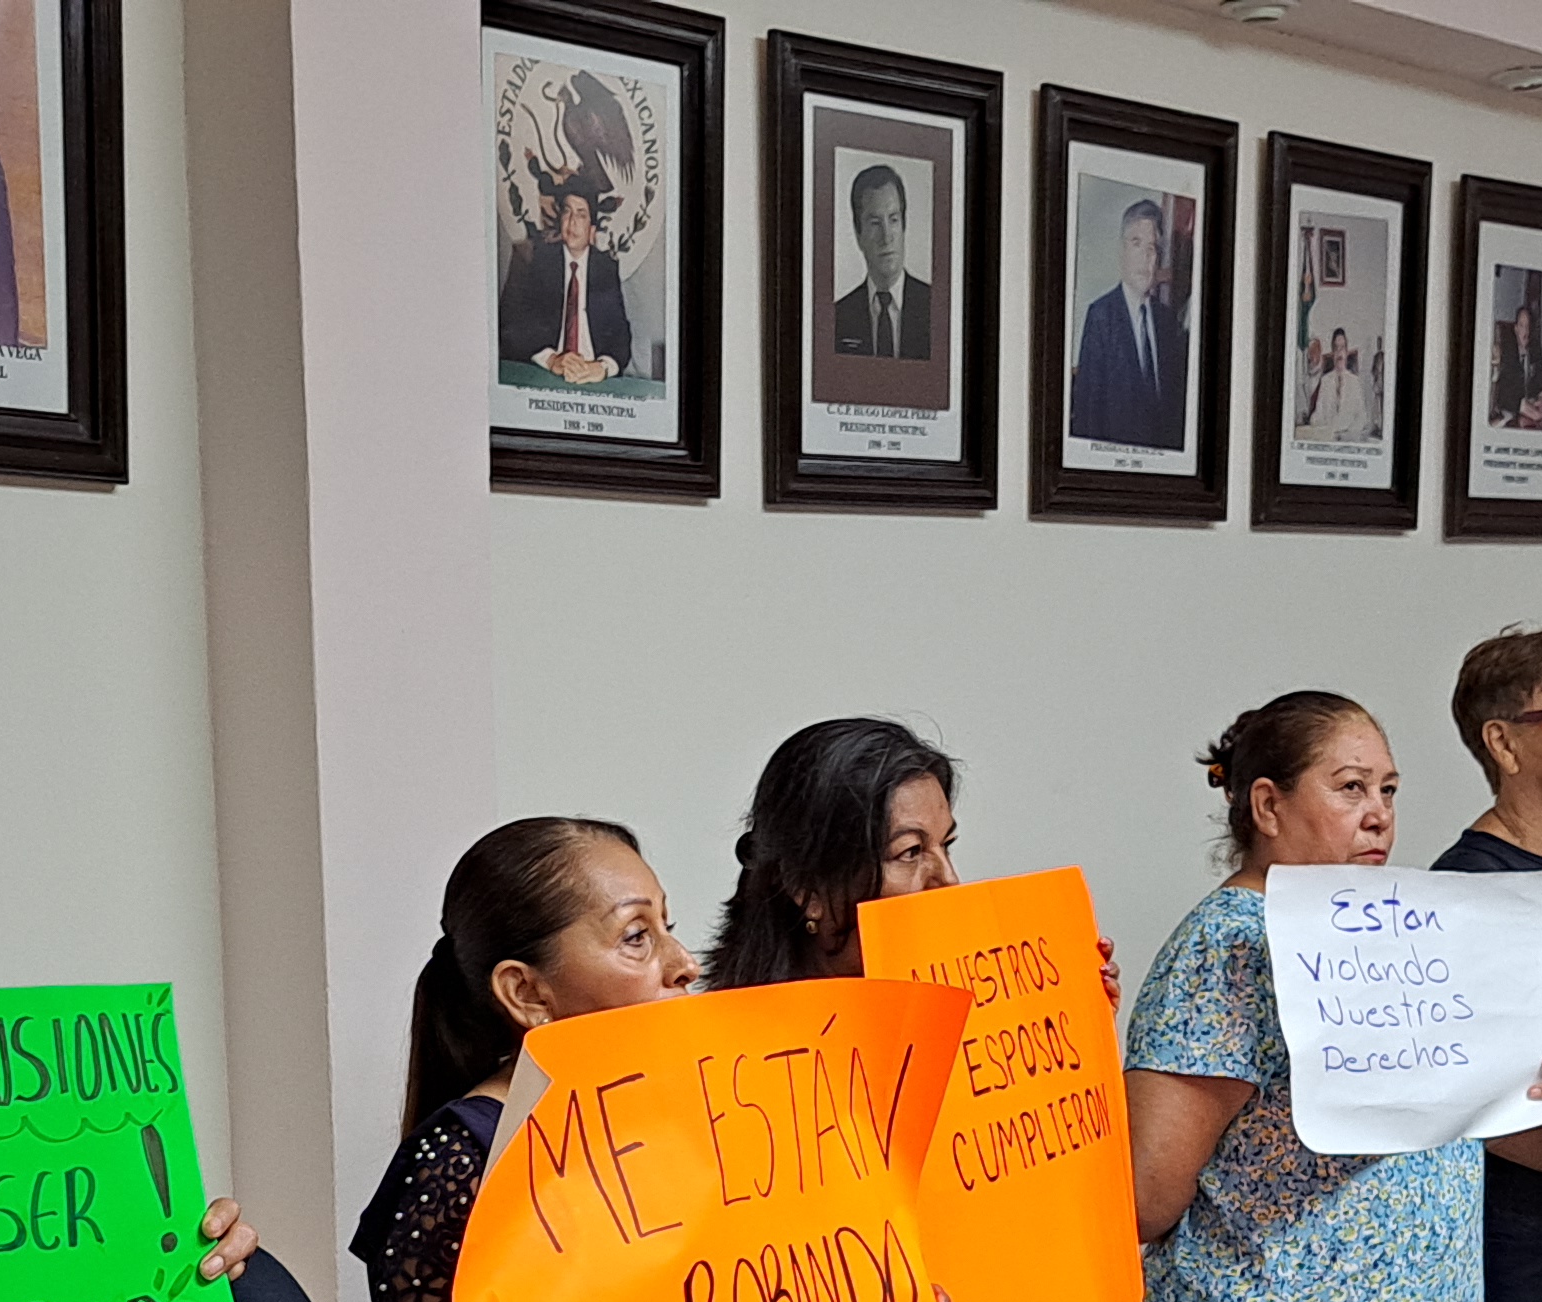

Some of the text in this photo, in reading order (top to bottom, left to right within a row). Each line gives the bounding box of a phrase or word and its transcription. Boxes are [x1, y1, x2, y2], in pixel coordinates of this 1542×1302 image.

[6, 345, 43, 361] VEGA
[528, 398, 637, 419] PRESIDENTE MUNICIPAL
[1331, 882, 1444, 938] Estan
[1297, 943, 1450, 986] Violando
[1317, 991, 1474, 1029] Nuestros
[962, 1011, 1081, 1098] ESPOSOS
[1322, 1037, 1470, 1072] Derechos
[525, 1013, 914, 1253] ME ESTÁN
[952, 1082, 1112, 1192] CUMPLIERON
